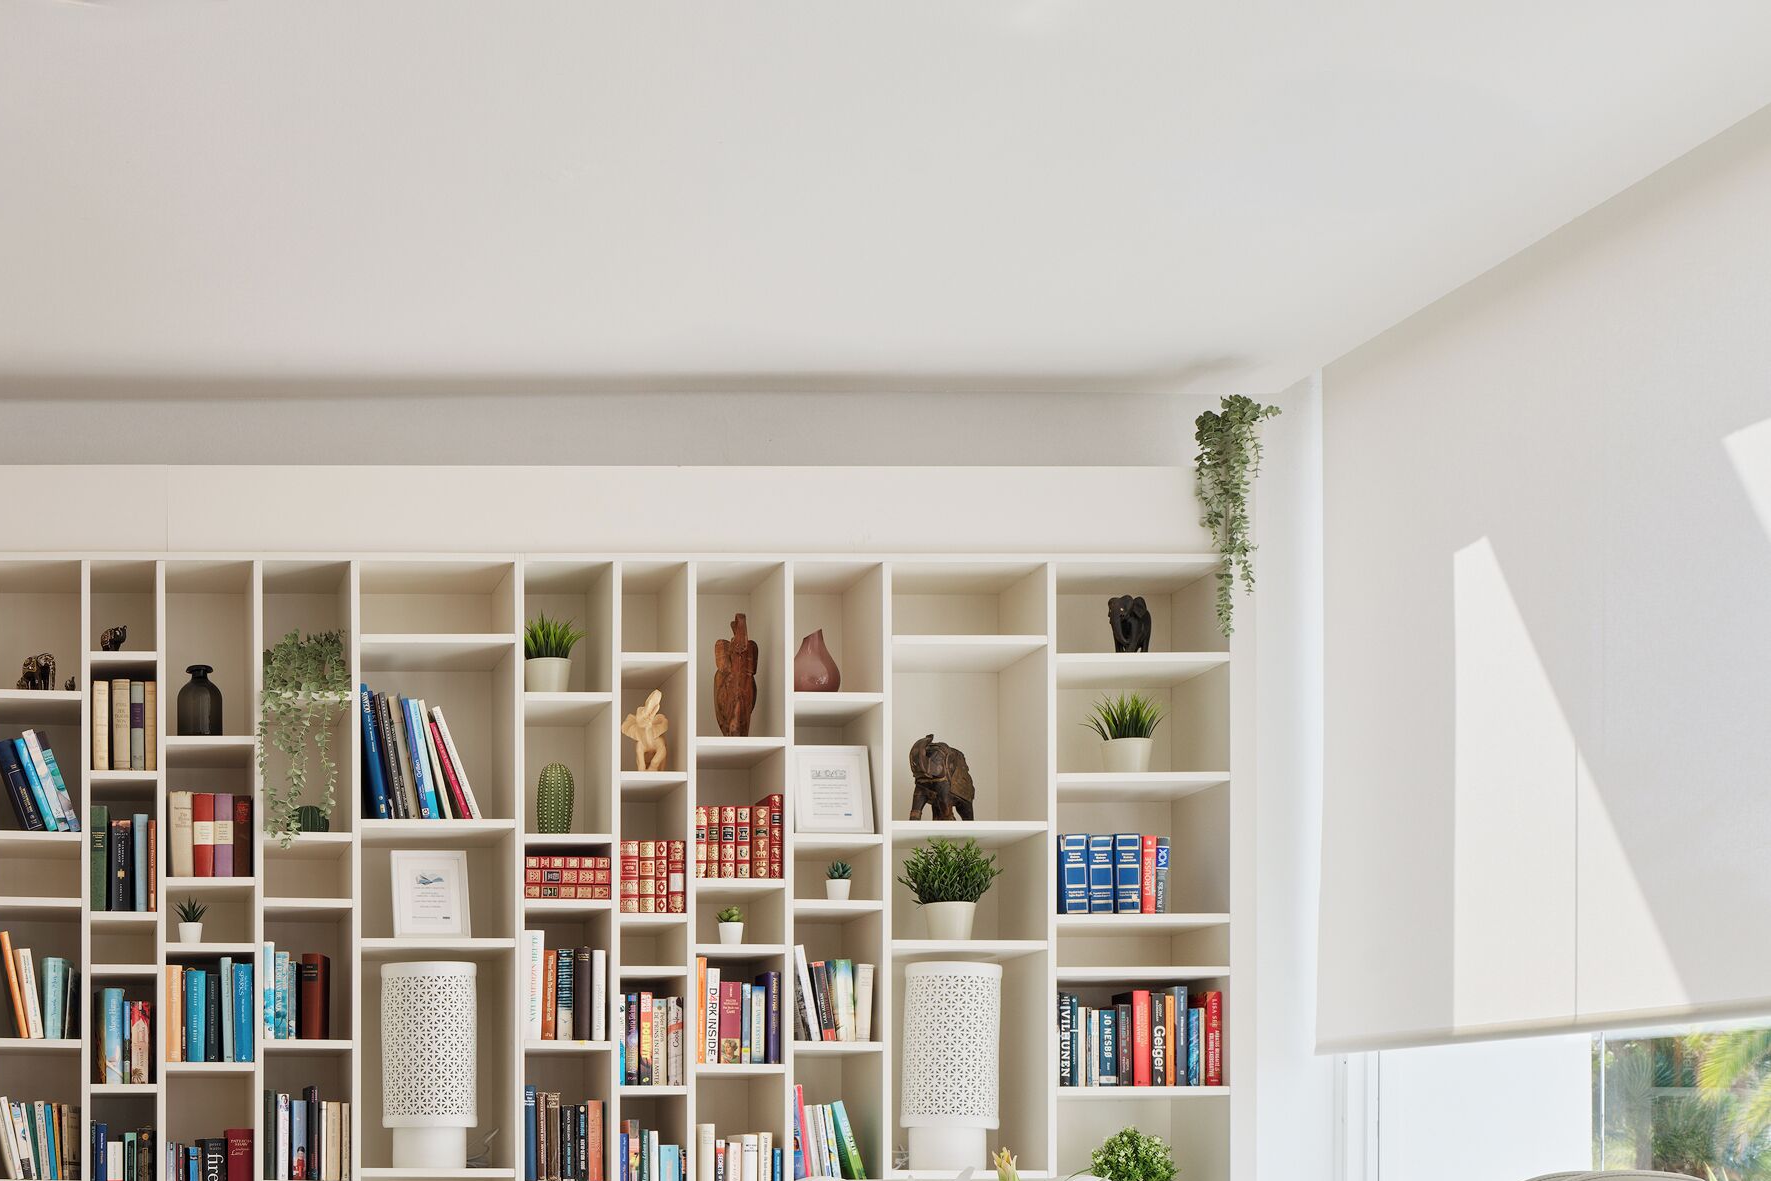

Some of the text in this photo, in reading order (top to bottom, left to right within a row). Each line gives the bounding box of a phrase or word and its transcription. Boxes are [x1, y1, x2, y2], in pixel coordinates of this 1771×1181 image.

[361, 692, 371, 713] OCEANOS
[1143, 857, 1151, 896] LAROUSSE
[1157, 849, 1168, 866] VOX
[642, 1022, 650, 1059] DOELWIT
[708, 1018, 717, 1056] INSIDE
[1104, 1014, 1112, 1058] JO NESBØ
[1152, 1025, 1165, 1072] Geiger
